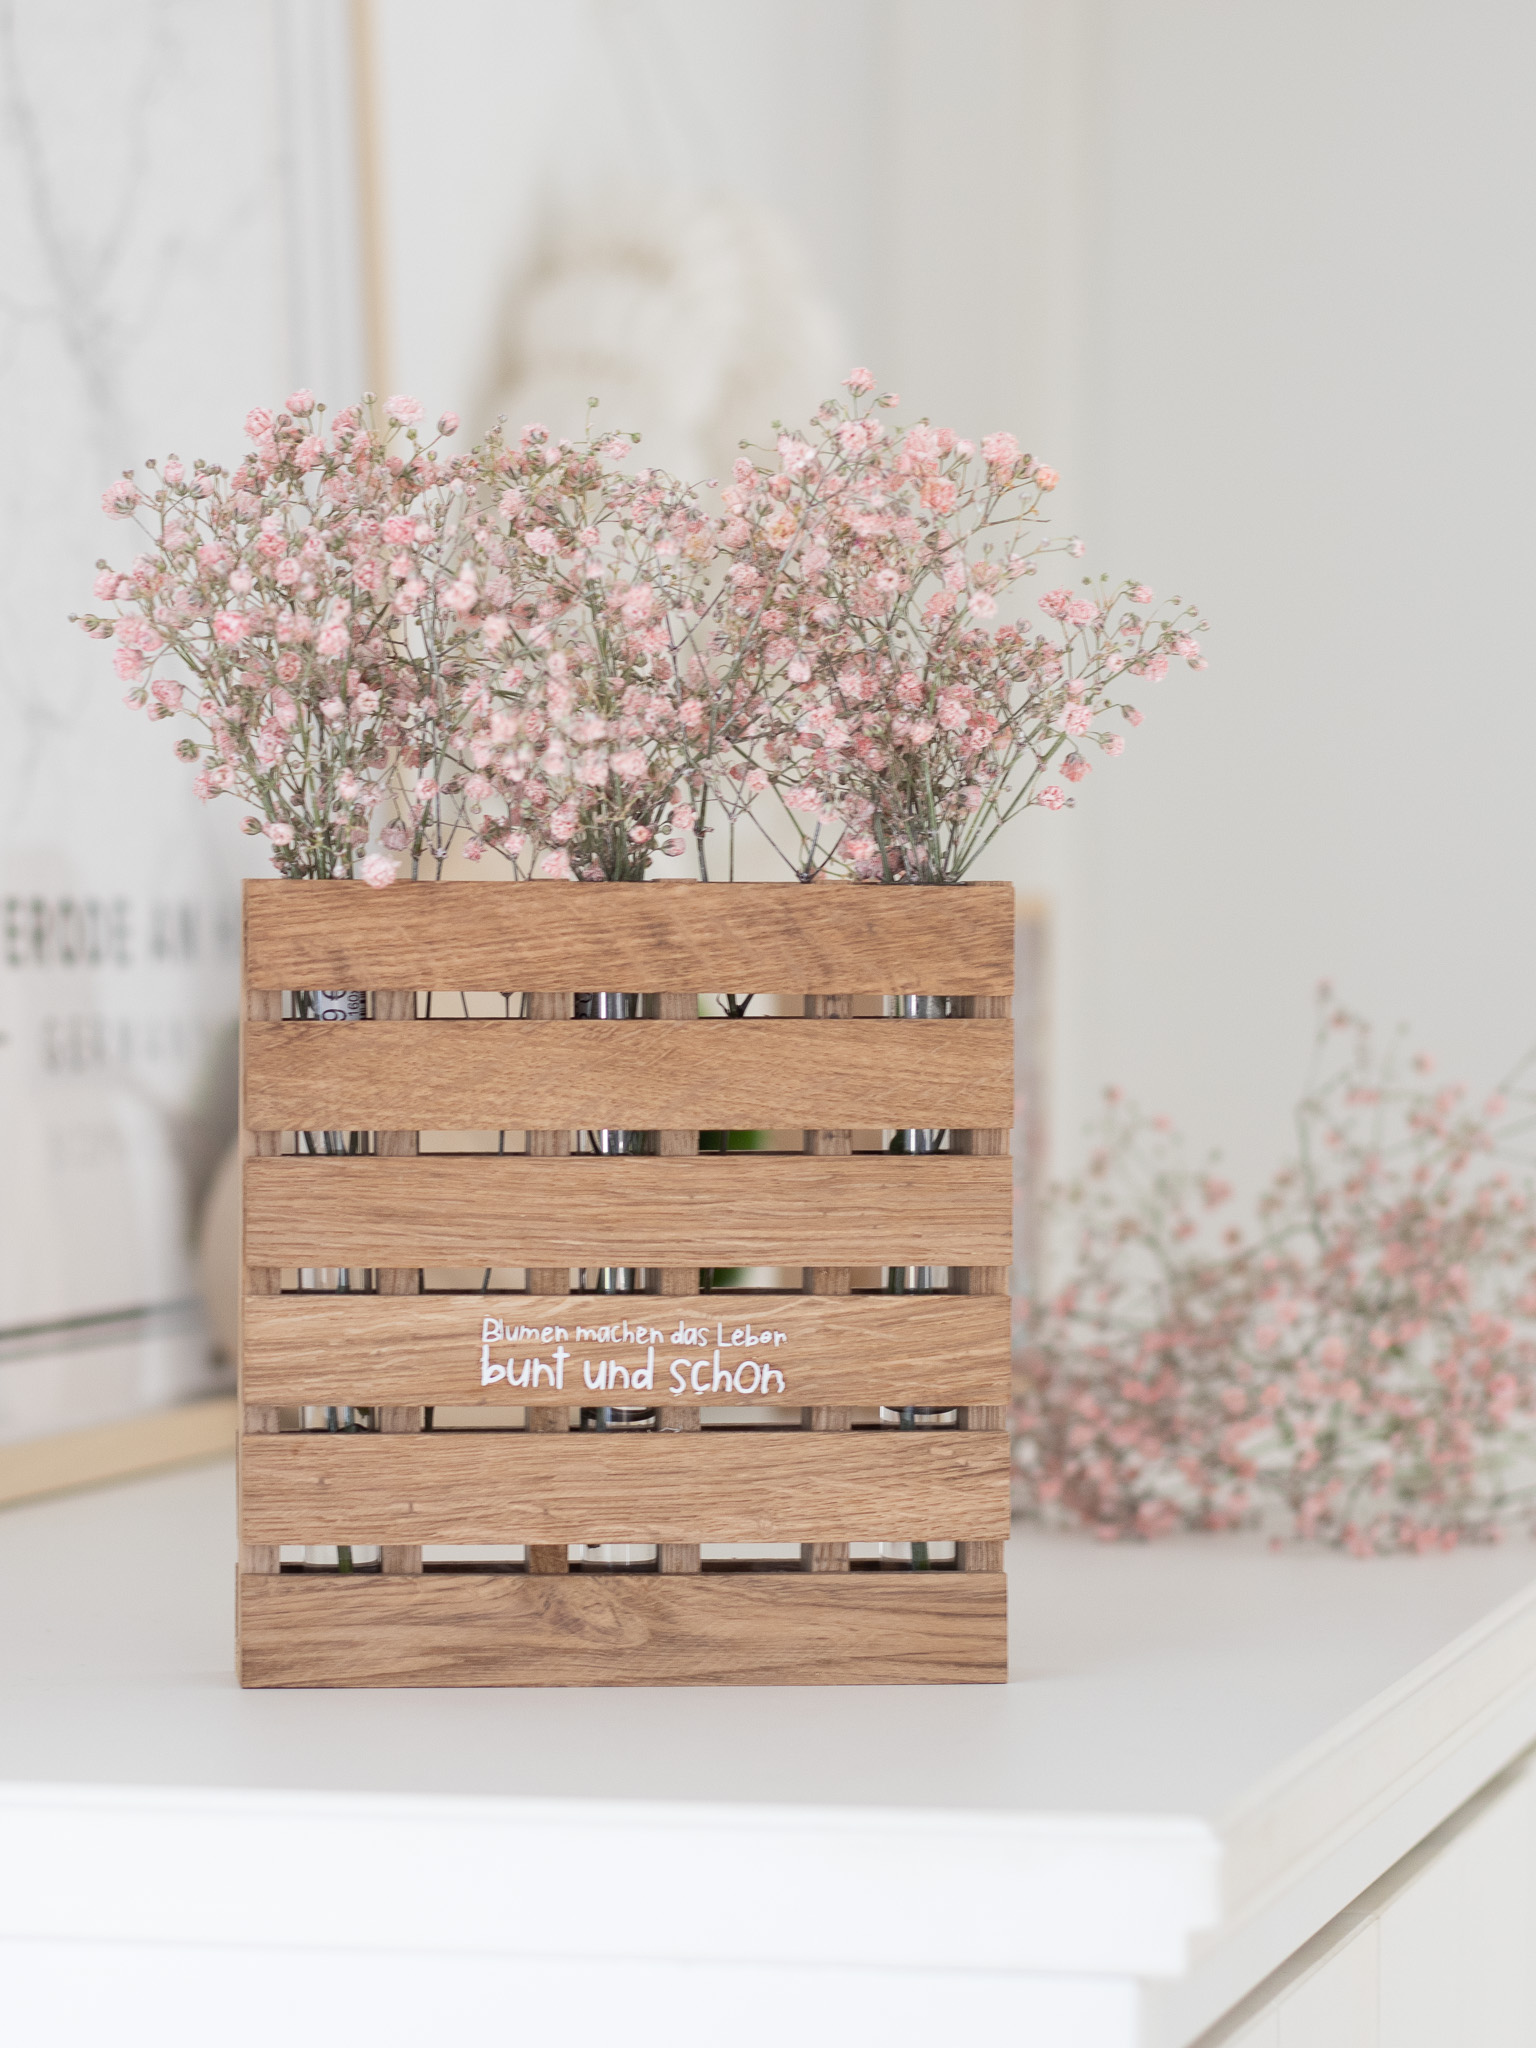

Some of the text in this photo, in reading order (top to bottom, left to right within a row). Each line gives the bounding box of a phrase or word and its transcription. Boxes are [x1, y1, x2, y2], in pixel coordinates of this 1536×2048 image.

[482, 1317, 788, 1347] Blumen machen das Leben
[480, 1344, 571, 1390] bunt
[583, 1346, 655, 1390] und
